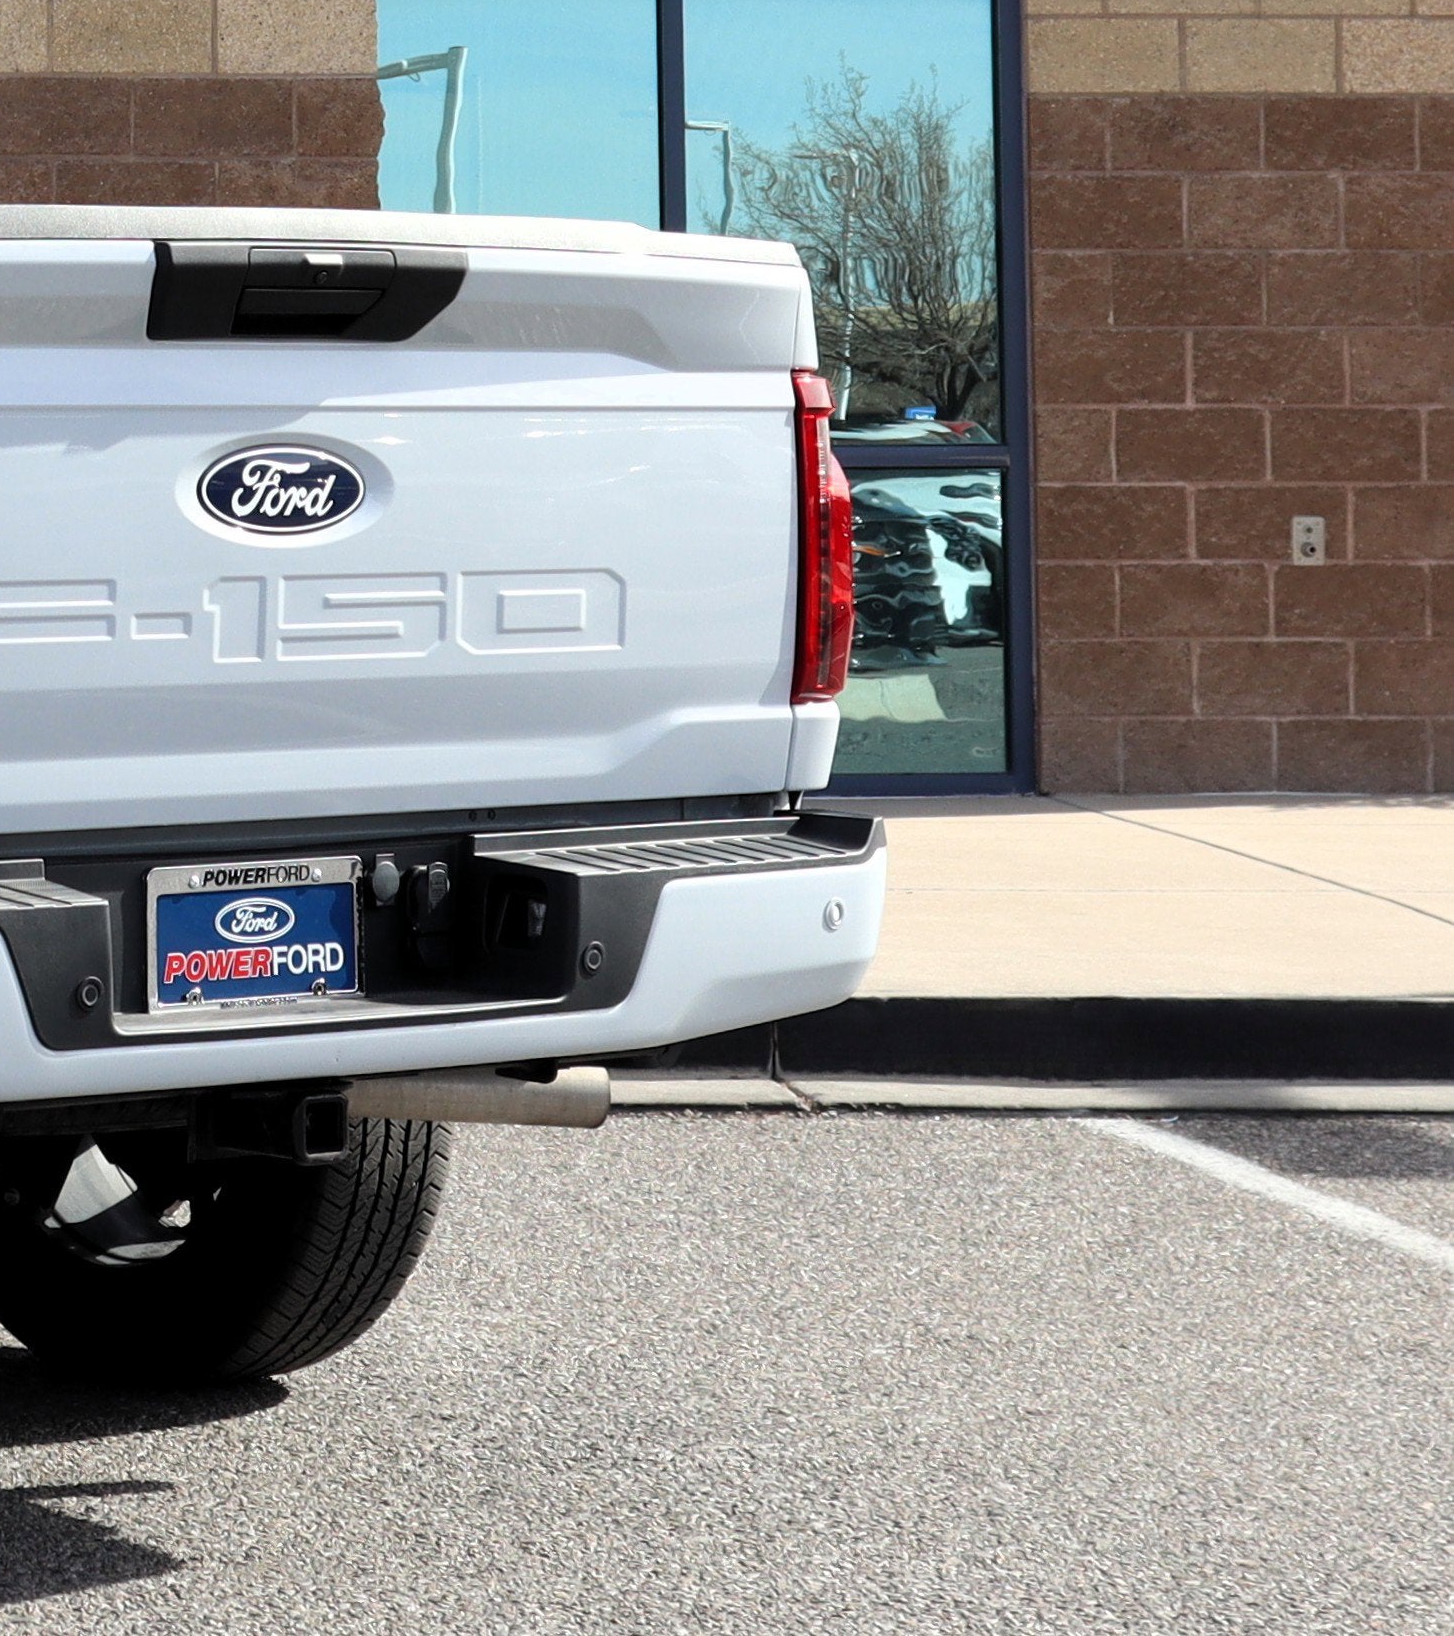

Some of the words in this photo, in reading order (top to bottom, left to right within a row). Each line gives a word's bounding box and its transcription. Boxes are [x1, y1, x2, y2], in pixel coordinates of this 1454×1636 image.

[231, 460, 335, 518] Ford
[202, 865, 310, 888] POWERFORD
[231, 906, 278, 933] Ford
[163, 942, 344, 984] POWERFORD
